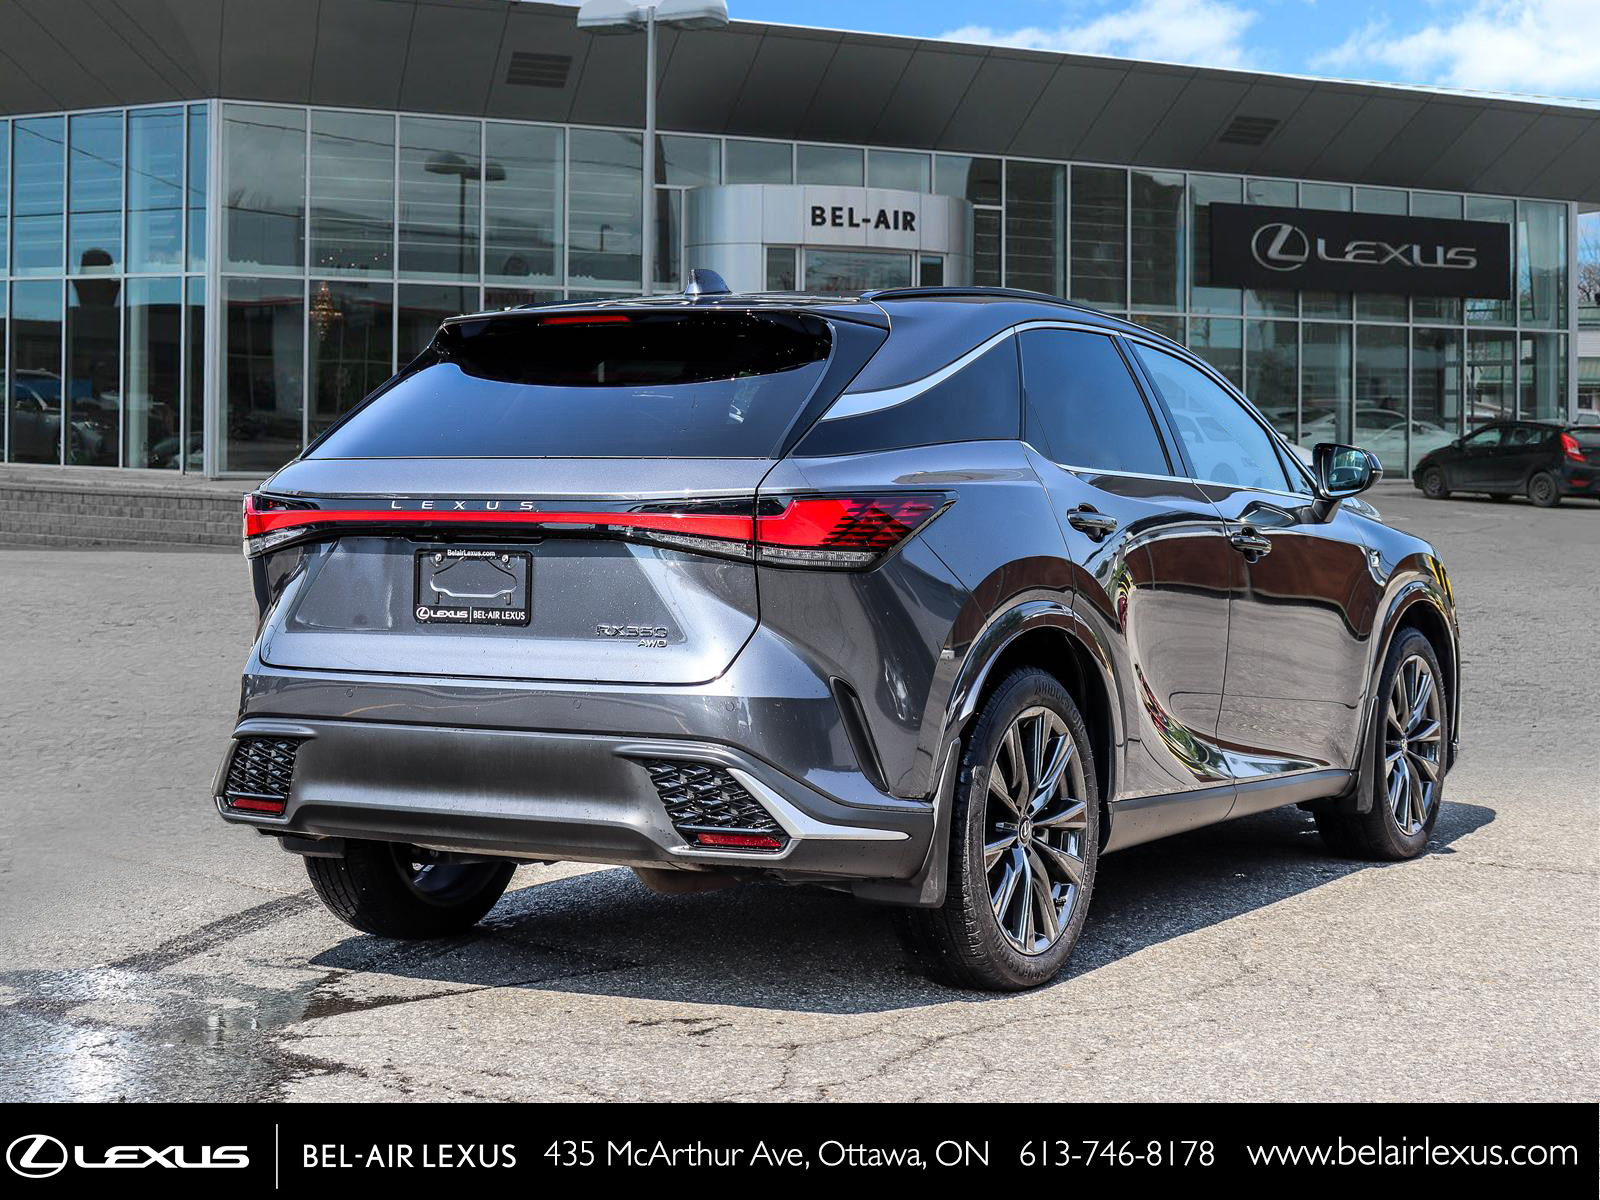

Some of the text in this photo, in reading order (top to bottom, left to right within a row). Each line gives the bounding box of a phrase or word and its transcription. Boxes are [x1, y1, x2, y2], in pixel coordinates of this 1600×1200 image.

[811, 205, 916, 232] BEL-AIR
[1316, 237, 1478, 270] LEXUS
[390, 500, 535, 511] LEXUS
[447, 549, 496, 558] BelairLexus.com
[430, 610, 469, 620] LEXUS
[473, 610, 526, 621] BEL-AIR LEXUS
[637, 639, 668, 649] AWD
